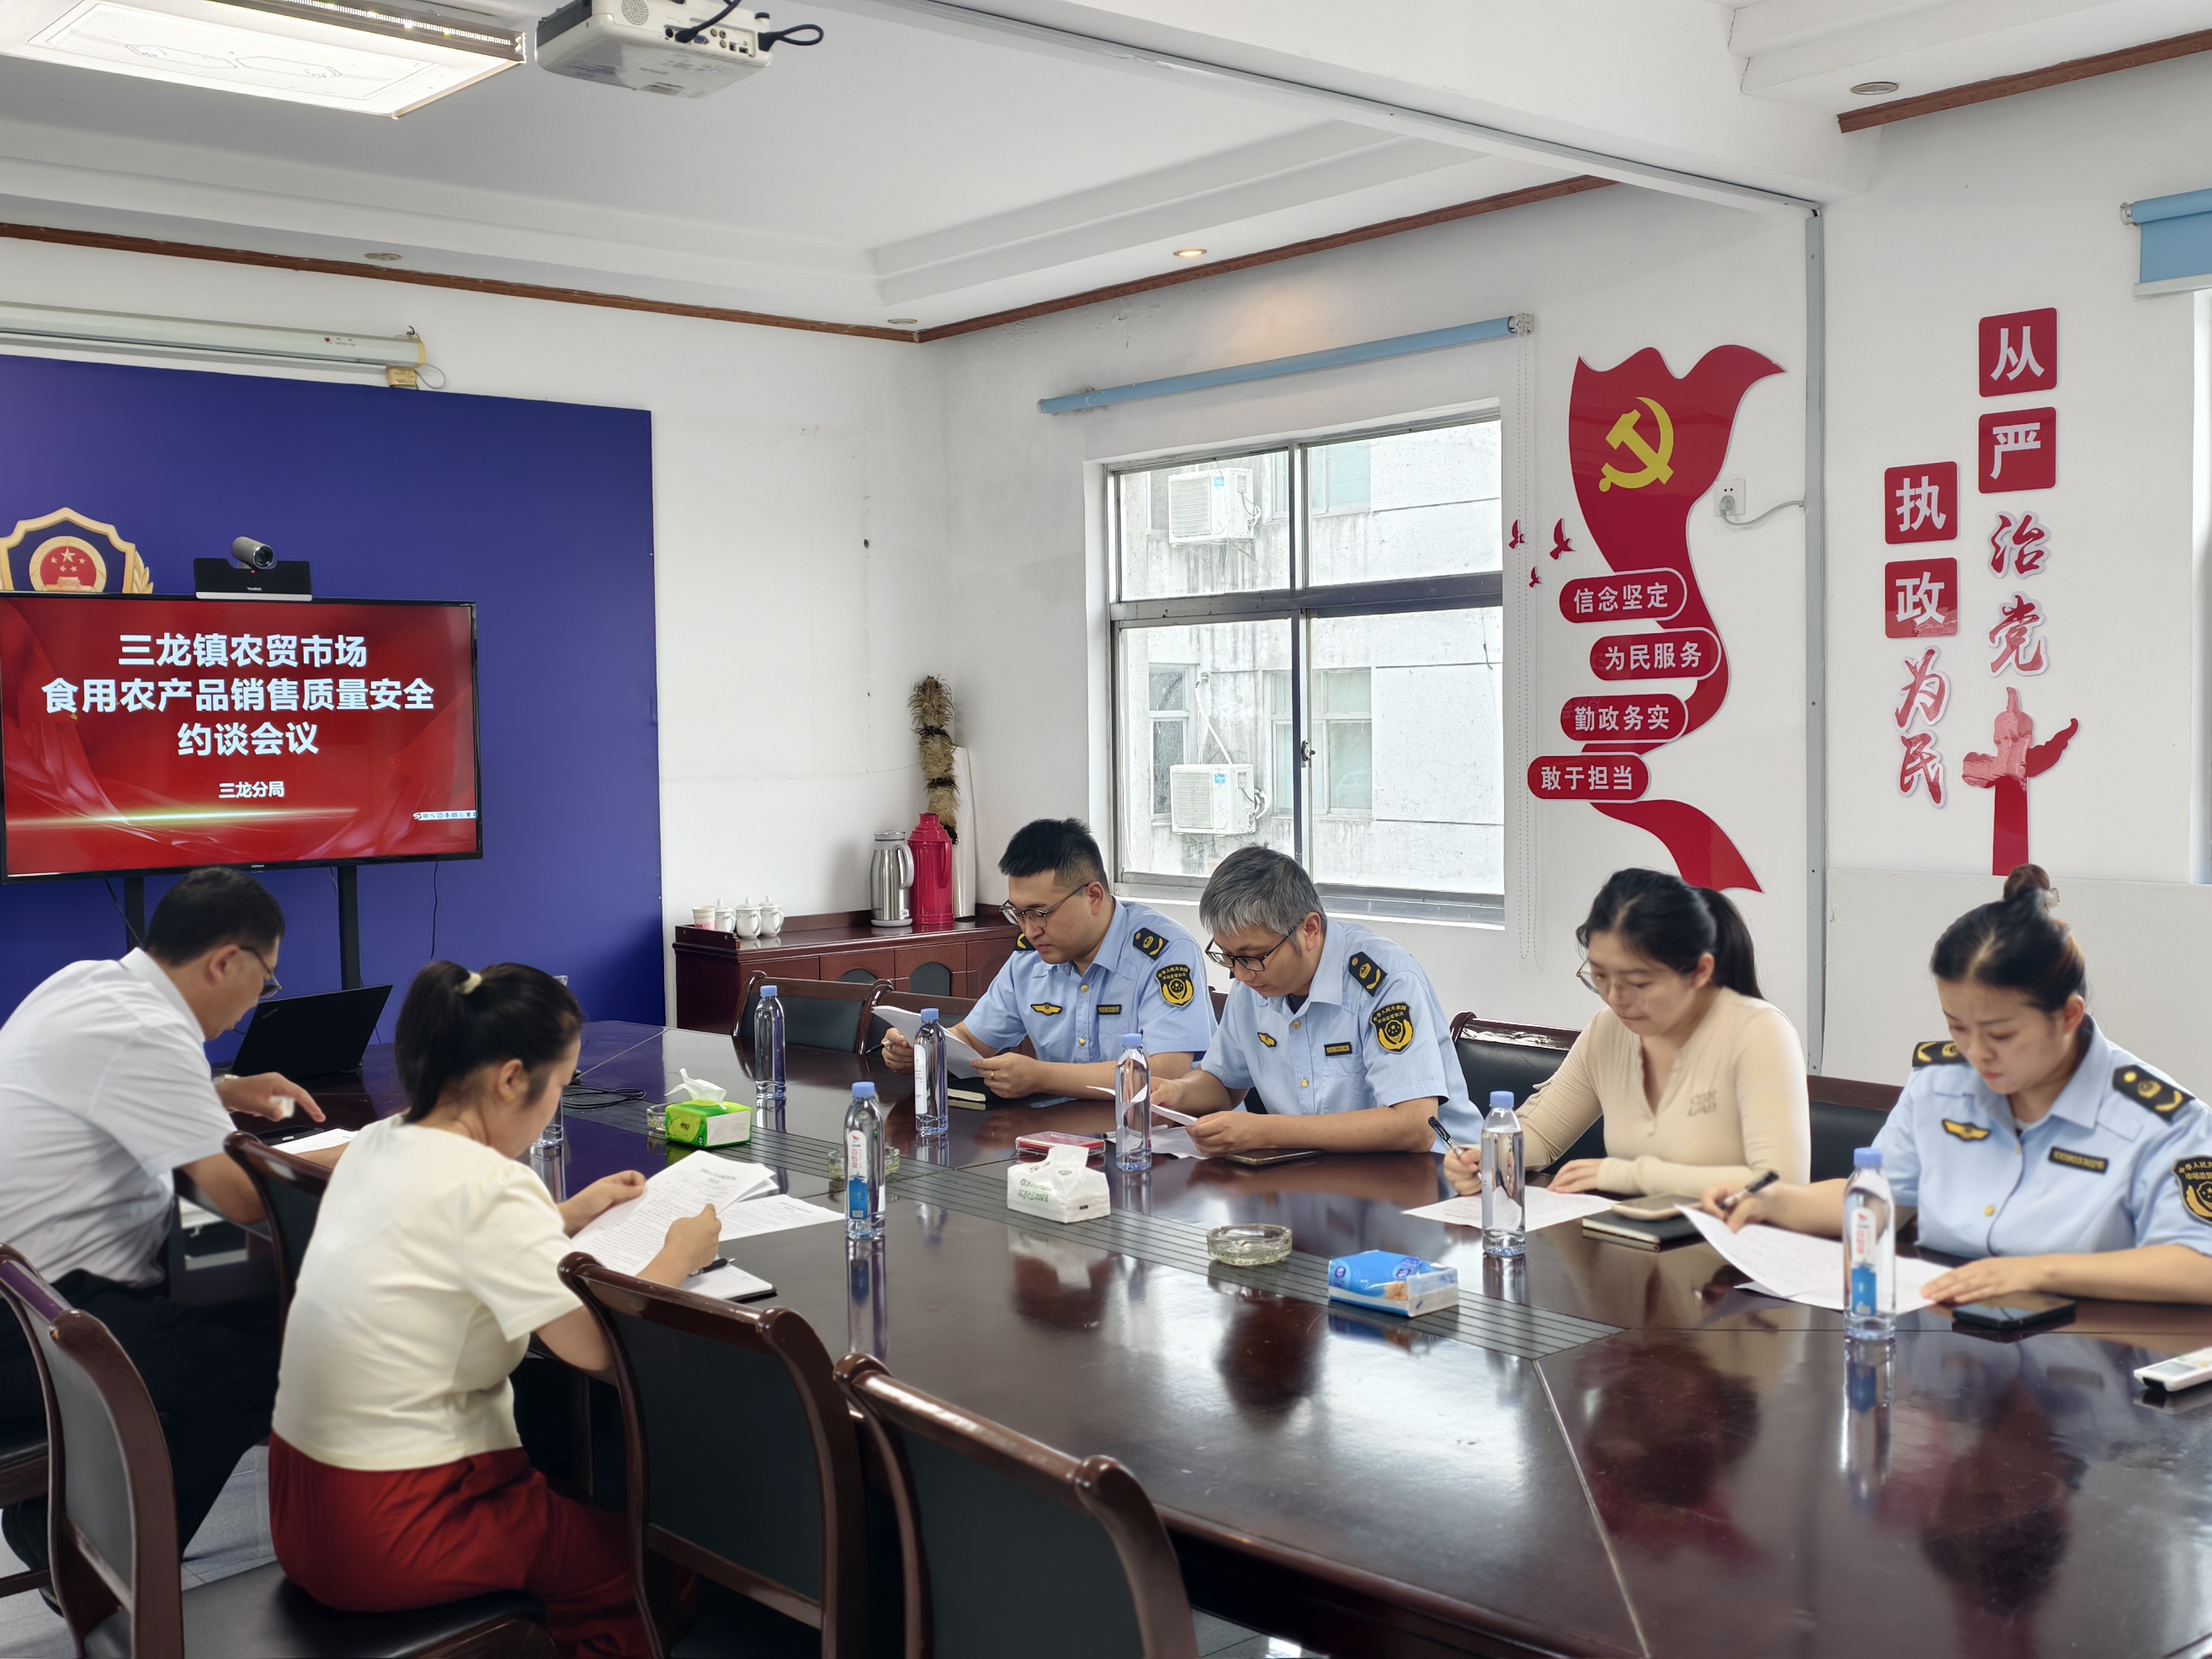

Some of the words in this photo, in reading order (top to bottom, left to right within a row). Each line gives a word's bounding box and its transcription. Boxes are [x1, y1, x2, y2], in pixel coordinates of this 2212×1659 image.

[1990, 326, 2044, 672] 从严治党
[1574, 582, 1668, 613] 信念坚定
[119, 633, 366, 667] 三龙镇农贸市场
[1605, 641, 1702, 671] 为民服务
[1895, 476, 1947, 805] 执政为民
[41, 678, 434, 713] 食用农产品销售质量安全
[1574, 705, 1670, 731] 勤政务实
[178, 722, 319, 756] 约谈会议
[219, 781, 284, 798] 三龙分局
[1541, 765, 1632, 790] 敢于担当
